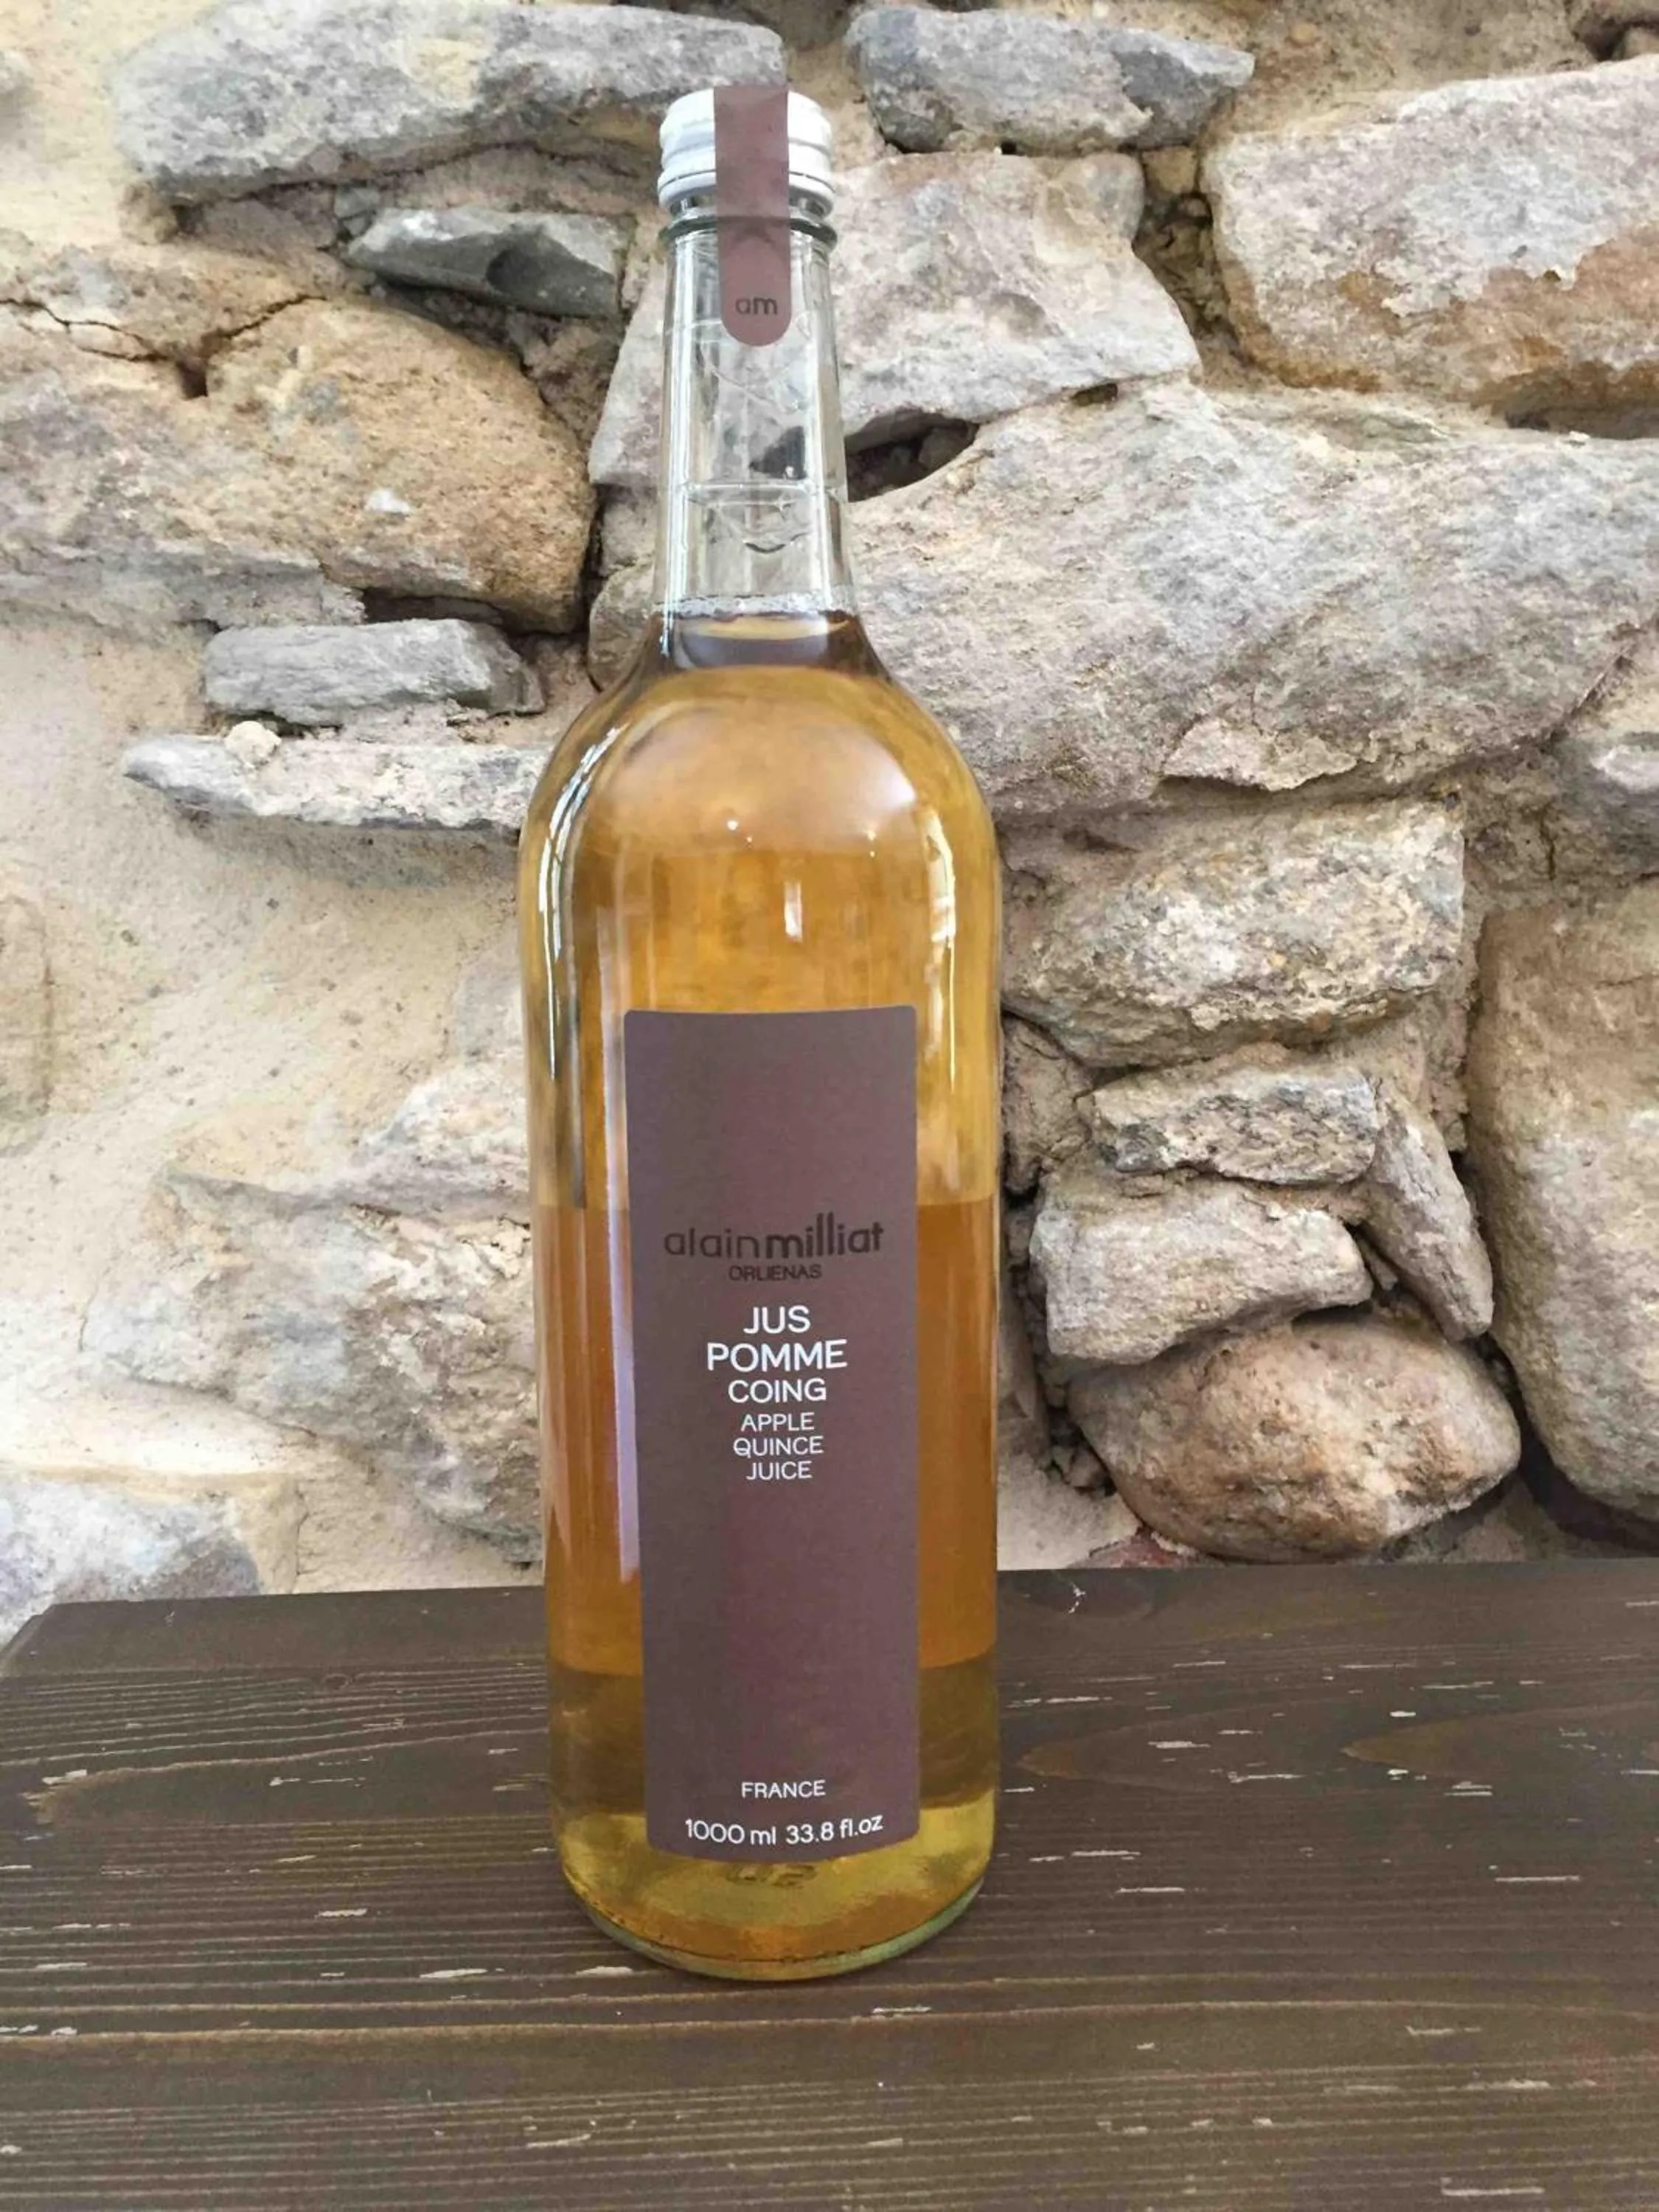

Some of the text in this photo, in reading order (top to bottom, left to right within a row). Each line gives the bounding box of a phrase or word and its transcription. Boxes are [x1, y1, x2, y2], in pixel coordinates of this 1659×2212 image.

[735, 296, 778, 316] am
[743, 1305, 811, 1334] JUS
[707, 1339, 848, 1372] POMME
[728, 1378, 827, 1403] COING
[740, 1412, 815, 1432] APPLE
[733, 1436, 824, 1458] QUINCE
[746, 1461, 812, 1481] JUICE
[741, 1780, 826, 1798] FRANCE
[685, 1815, 883, 1845] 1000 ml 33.8 fl.oz
